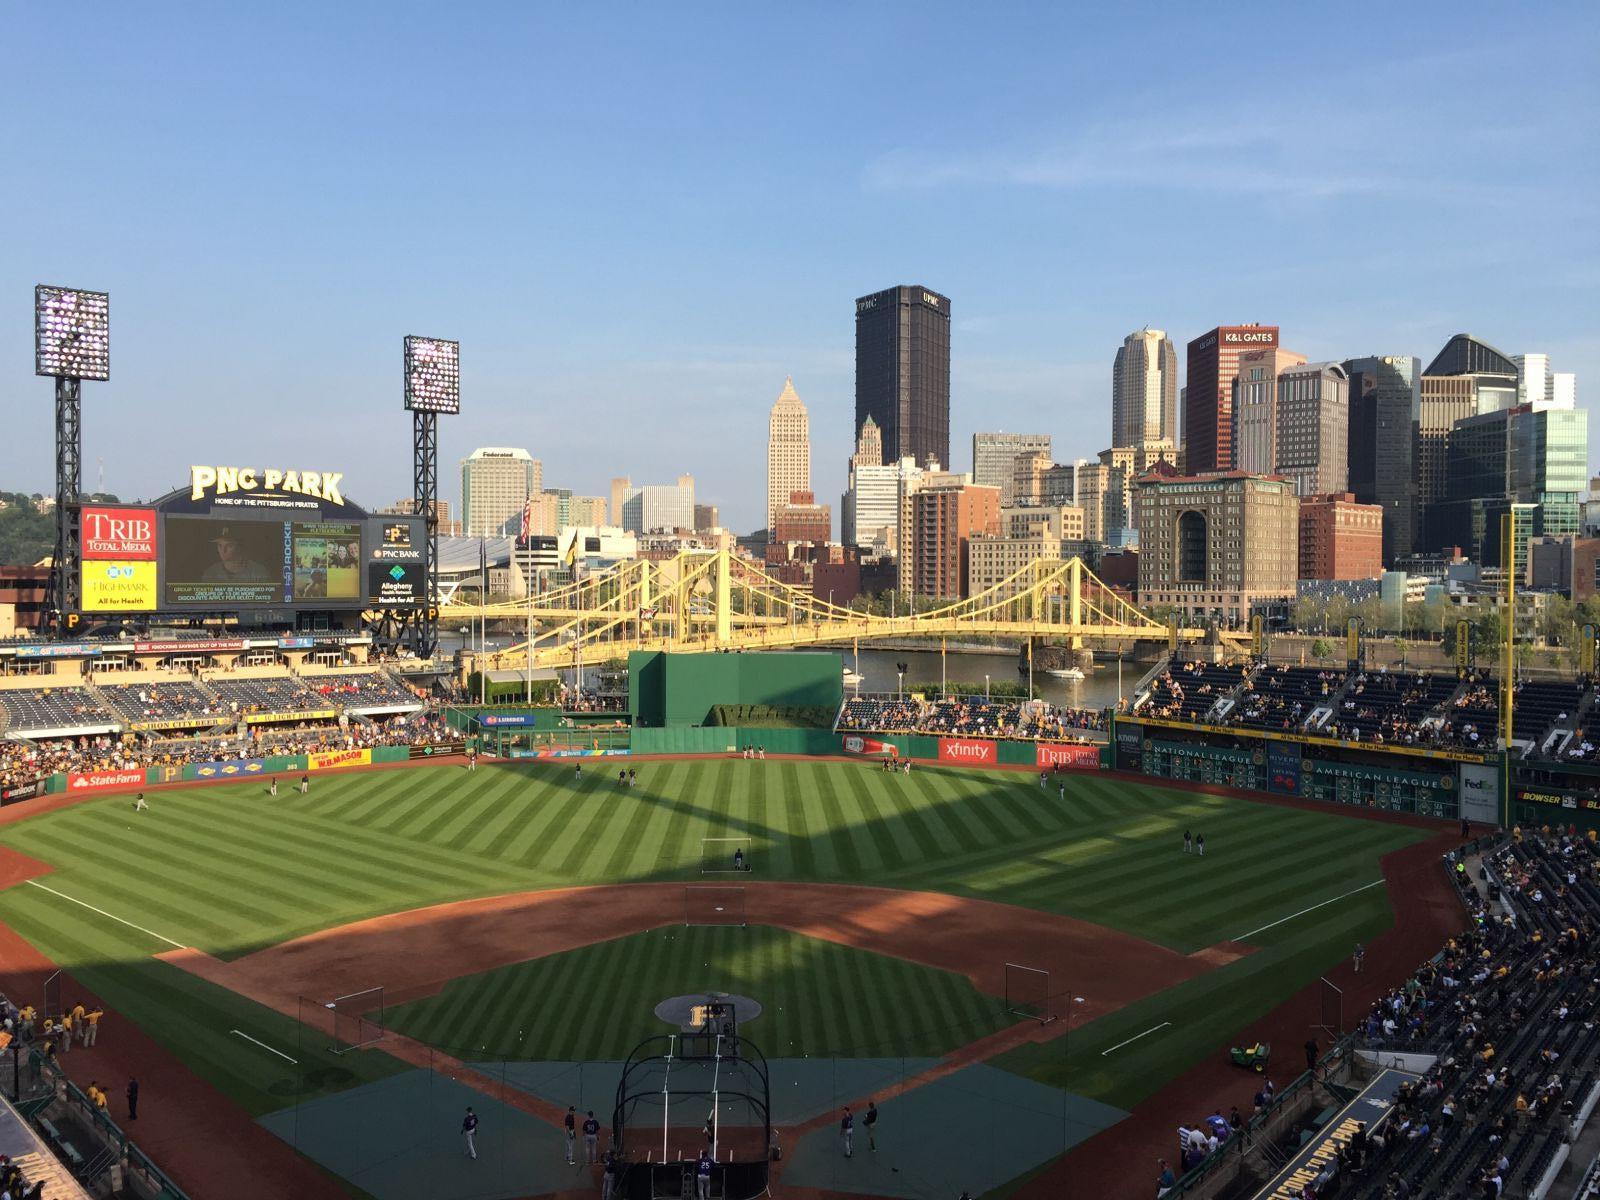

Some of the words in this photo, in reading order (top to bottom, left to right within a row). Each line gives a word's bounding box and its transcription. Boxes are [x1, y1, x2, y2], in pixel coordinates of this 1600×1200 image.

[923, 292, 939, 307] UPMC
[1225, 333, 1241, 342] K&L
[1243, 333, 1273, 342] GATES
[191, 465, 258, 501] PNC
[264, 468, 345, 507] PARK
[257, 500, 294, 508] PITTSBURGH
[86, 513, 151, 541] TRIB
[87, 541, 120, 552] TOTAL
[121, 541, 152, 552] MEDIA
[381, 582, 413, 592] Allegheny
[68, 614, 78, 628] P
[196, 719, 218, 727] BEER
[946, 742, 988, 758] xfinity
[1038, 748, 1072, 764] TRIB
[1074, 750, 1096, 758] TOTAL
[1154, 746, 1205, 758] NATIONAL
[1210, 753, 1250, 764] LEAGUE
[166, 768, 176, 782] P
[1316, 768, 1380, 780] AMERICAN
[1386, 776, 1438, 788] LEAGUE
[1464, 778, 1494, 790] FedEx
[1523, 792, 1560, 804] BOWSER
[1312, 1138, 1338, 1161] PNC
[1330, 1117, 1368, 1142] PARK
